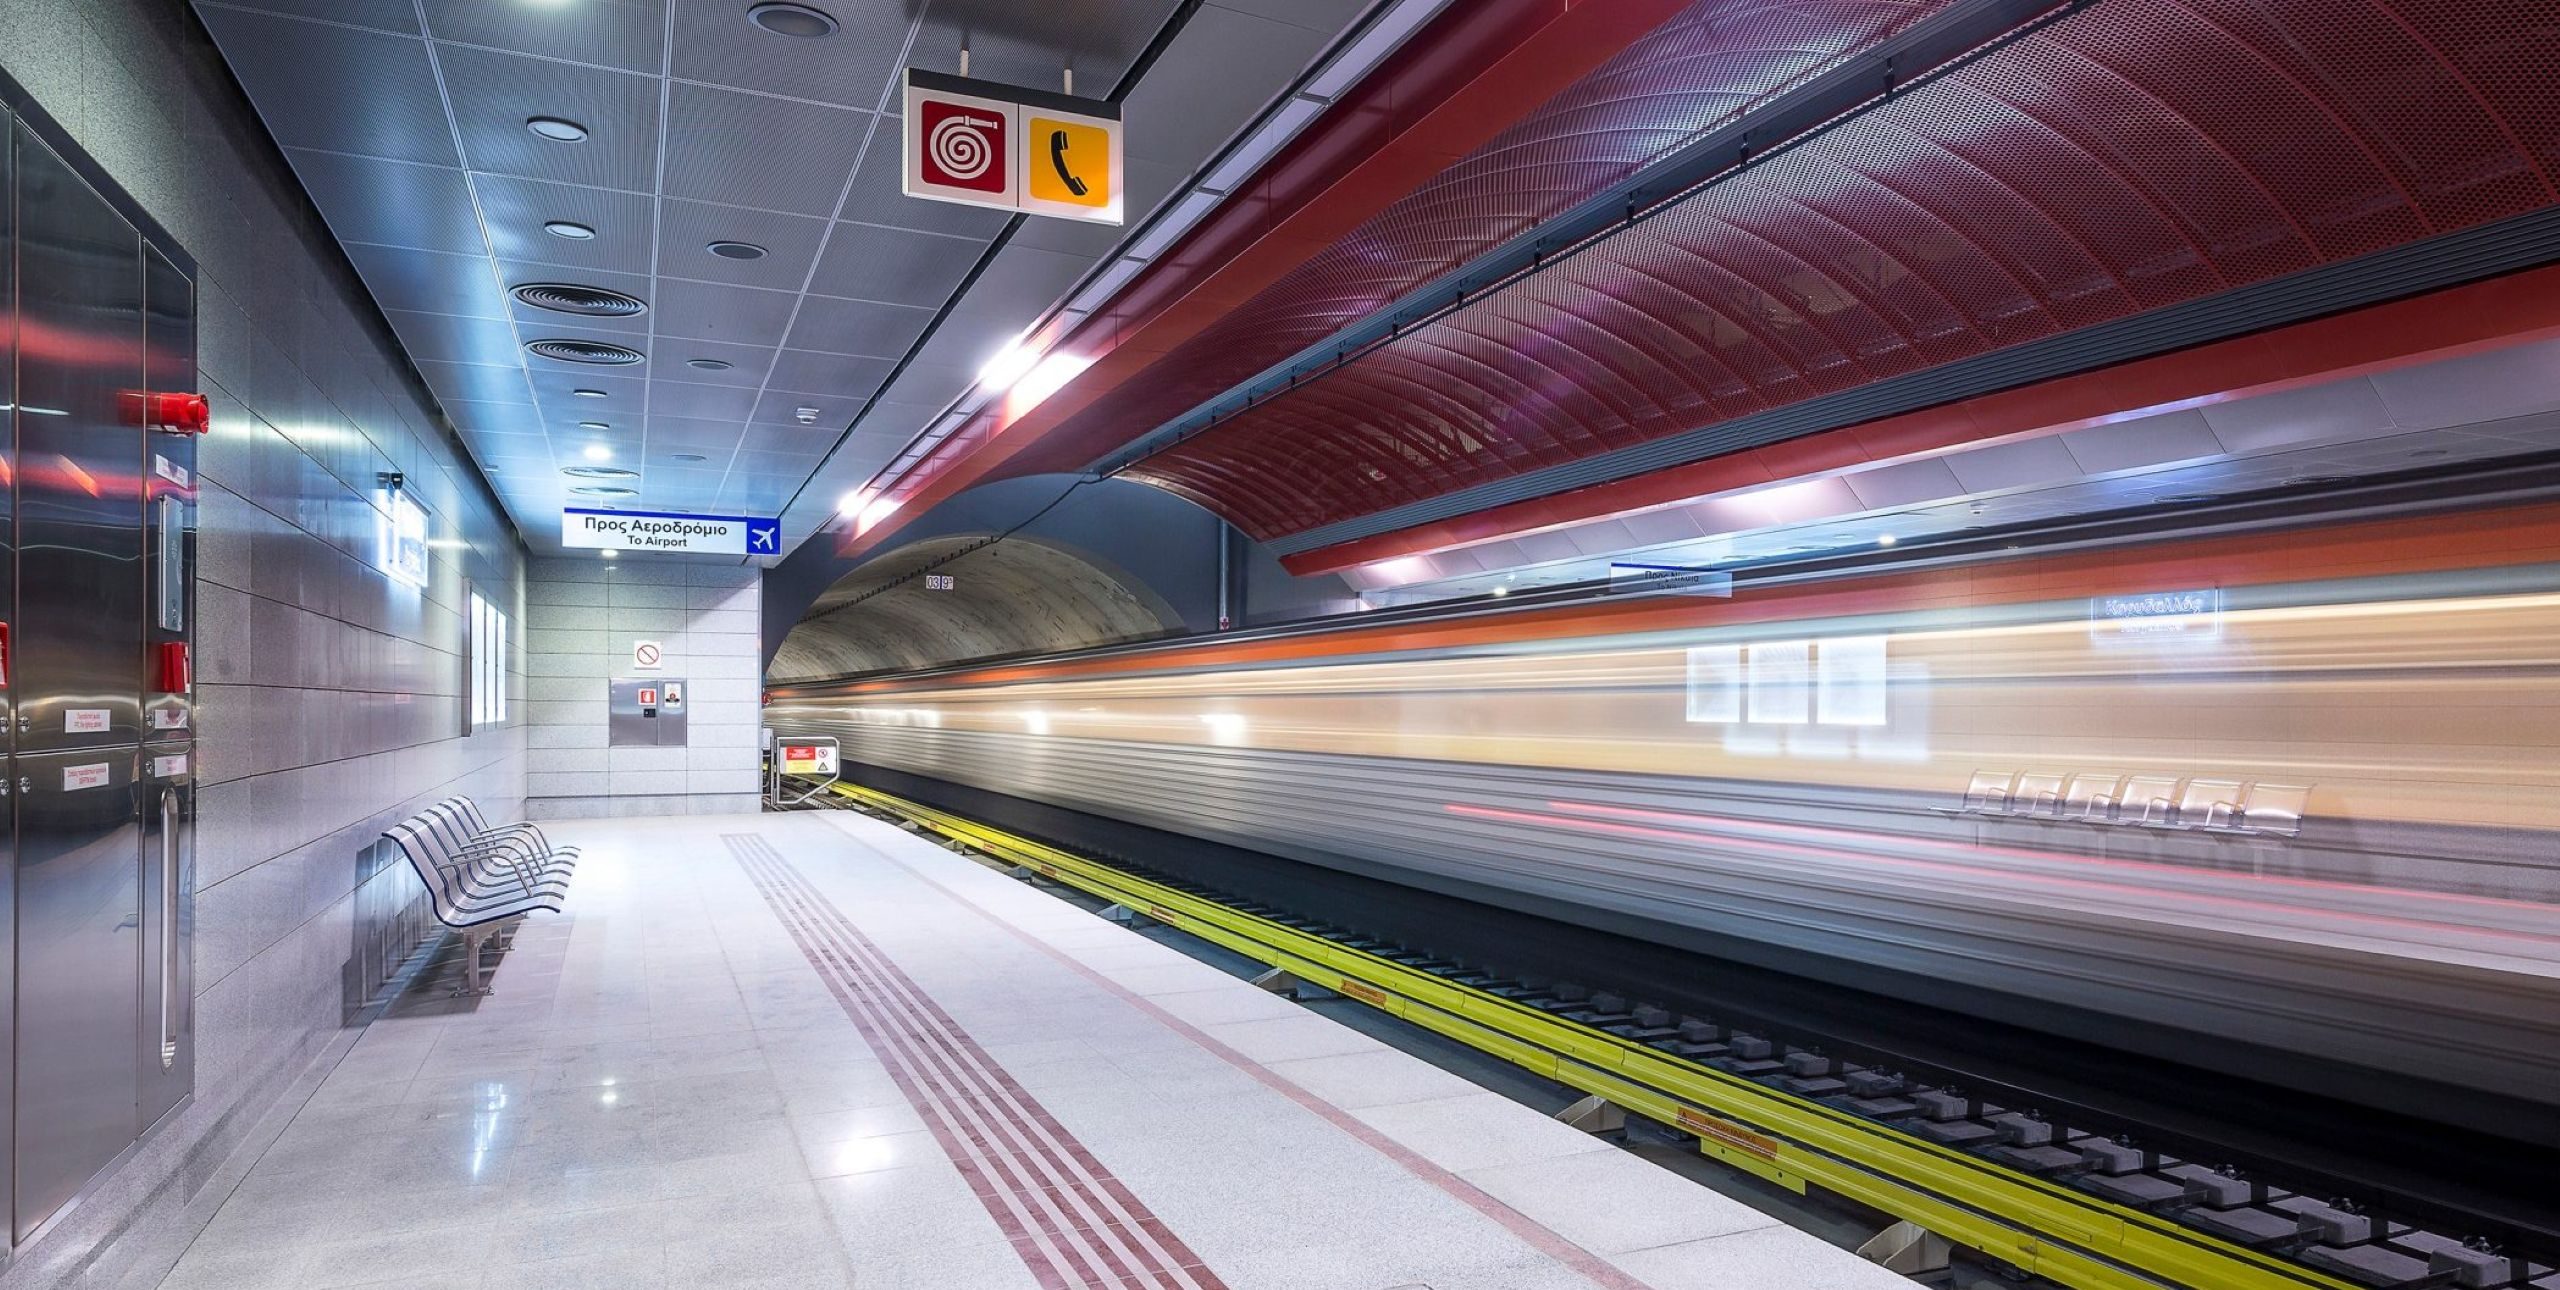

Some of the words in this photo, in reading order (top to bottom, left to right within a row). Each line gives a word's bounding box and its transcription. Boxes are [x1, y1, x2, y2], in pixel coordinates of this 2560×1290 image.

[585, 516, 627, 534] Προς
[631, 519, 727, 537] Αεροδρόμιο
[627, 534, 643, 545] To
[645, 536, 688, 548] Airport
